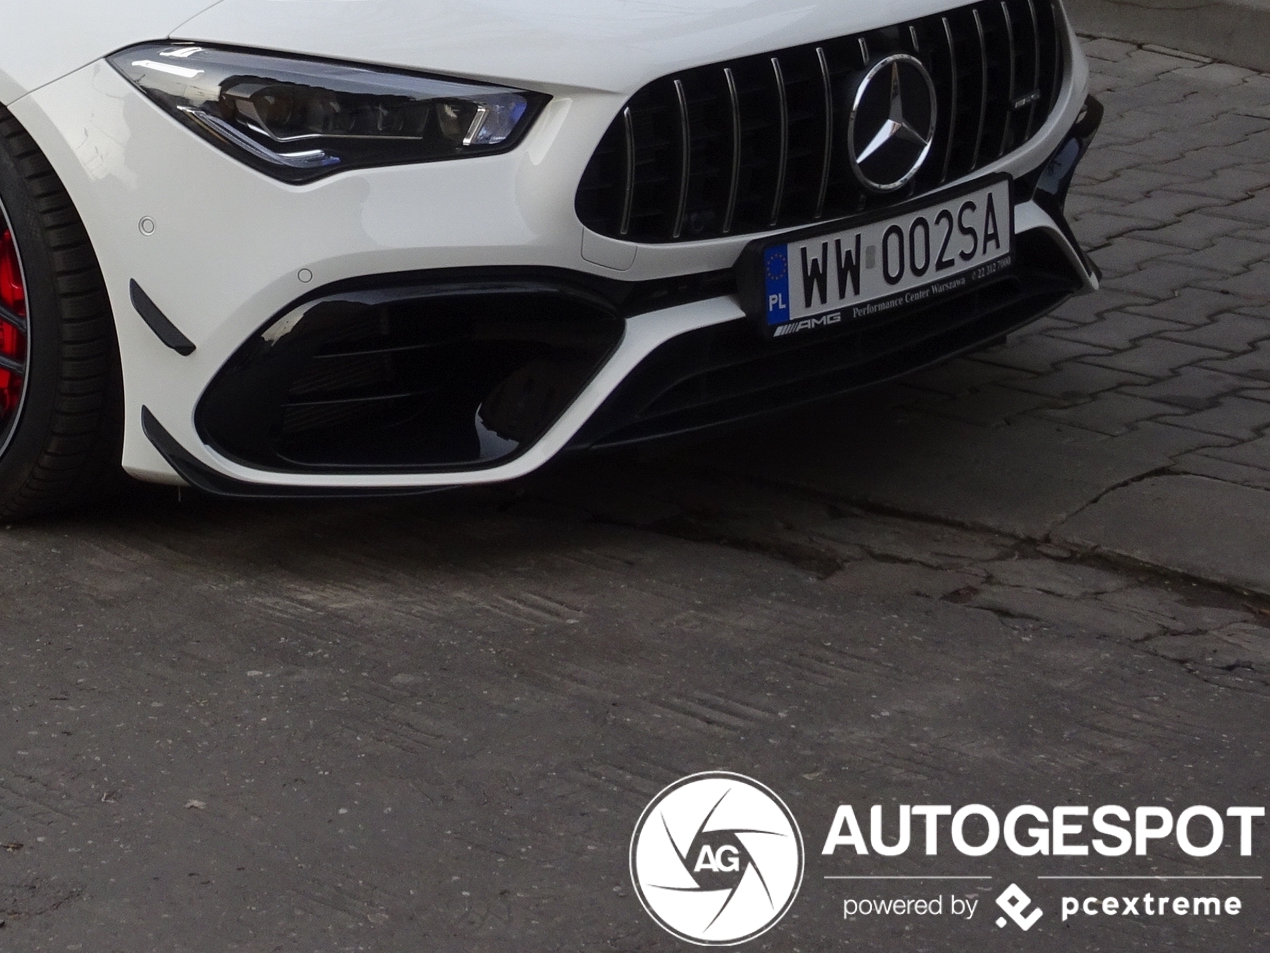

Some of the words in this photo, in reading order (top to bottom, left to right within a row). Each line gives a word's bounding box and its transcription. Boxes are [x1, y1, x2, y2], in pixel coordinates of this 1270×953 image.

[800, 234, 862, 309] WW
[882, 192, 1001, 286] 002SA
[768, 293, 786, 312] PL
[786, 312, 841, 335] AMG
[852, 298, 904, 318] Performance
[904, 288, 930, 303] Center
[931, 277, 966, 294] Warszawa
